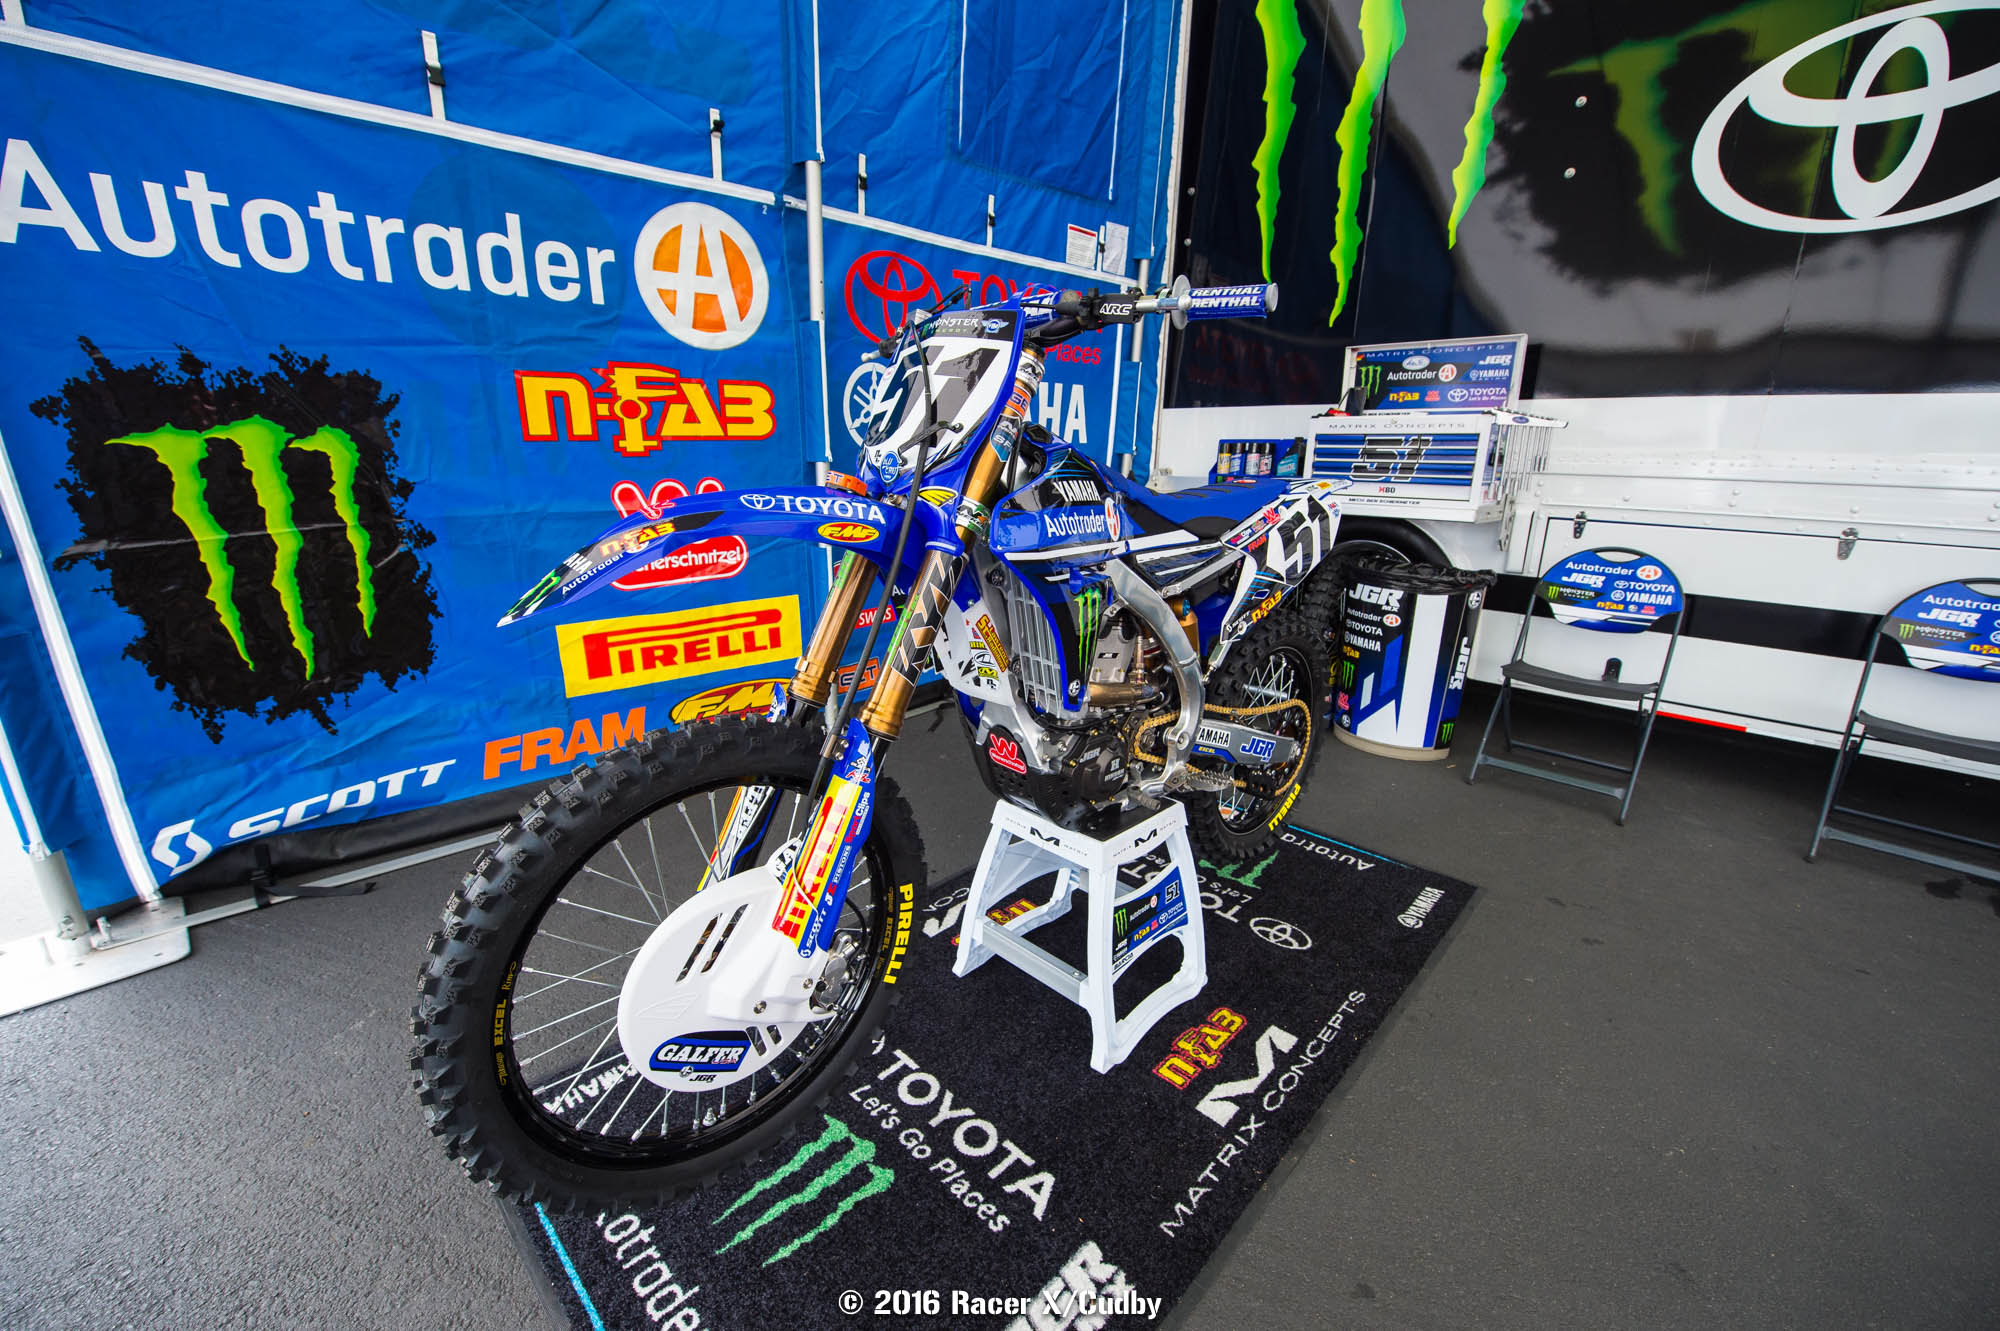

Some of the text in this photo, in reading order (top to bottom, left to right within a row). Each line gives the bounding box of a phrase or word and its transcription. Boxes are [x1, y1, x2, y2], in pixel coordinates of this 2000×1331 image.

[0, 138, 615, 304] Autotrader
[1191, 296, 1262, 308] RENTHAL
[1192, 287, 1263, 297] RENTHAL
[1099, 303, 1133, 316] ARC
[928, 317, 979, 330] MONSTER
[1422, 344, 1505, 355] CONCEPTS
[1387, 369, 1438, 381] Autotrader
[1479, 369, 1509, 377] YAMAHA
[1468, 387, 1507, 395] TOYOTA
[1053, 480, 1101, 502] YAMAHA
[776, 495, 886, 525] TOYOTA
[822, 525, 879, 540] FMF
[1043, 509, 1105, 538] Autotrader
[1565, 561, 1635, 576] Autotrader
[1348, 583, 1404, 607] JGR
[1629, 582, 1675, 593] TOYOTA
[1626, 592, 1673, 606] YAMAHA
[1351, 620, 1383, 636] TOYOTA
[583, 608, 782, 680] PIRELLI
[1350, 633, 1381, 652] YAMAHA
[483, 707, 646, 780] FRAM
[1199, 727, 1231, 746] AMAHA
[1241, 736, 1276, 758] JGR
[228, 759, 456, 841] SCOTT
[1268, 783, 1301, 831] PIRELLI
[1164, 880, 1180, 905] 51
[1408, 886, 1445, 919] YAMAHA
[883, 883, 914, 985] PIRELLI
[494, 999, 507, 1047] EXCEL
[1159, 990, 1366, 1238] MATRIX CONCEPTS
[877, 1049, 1056, 1222] TOYOTA
[849, 1084, 1011, 1233] Let's Go Places
